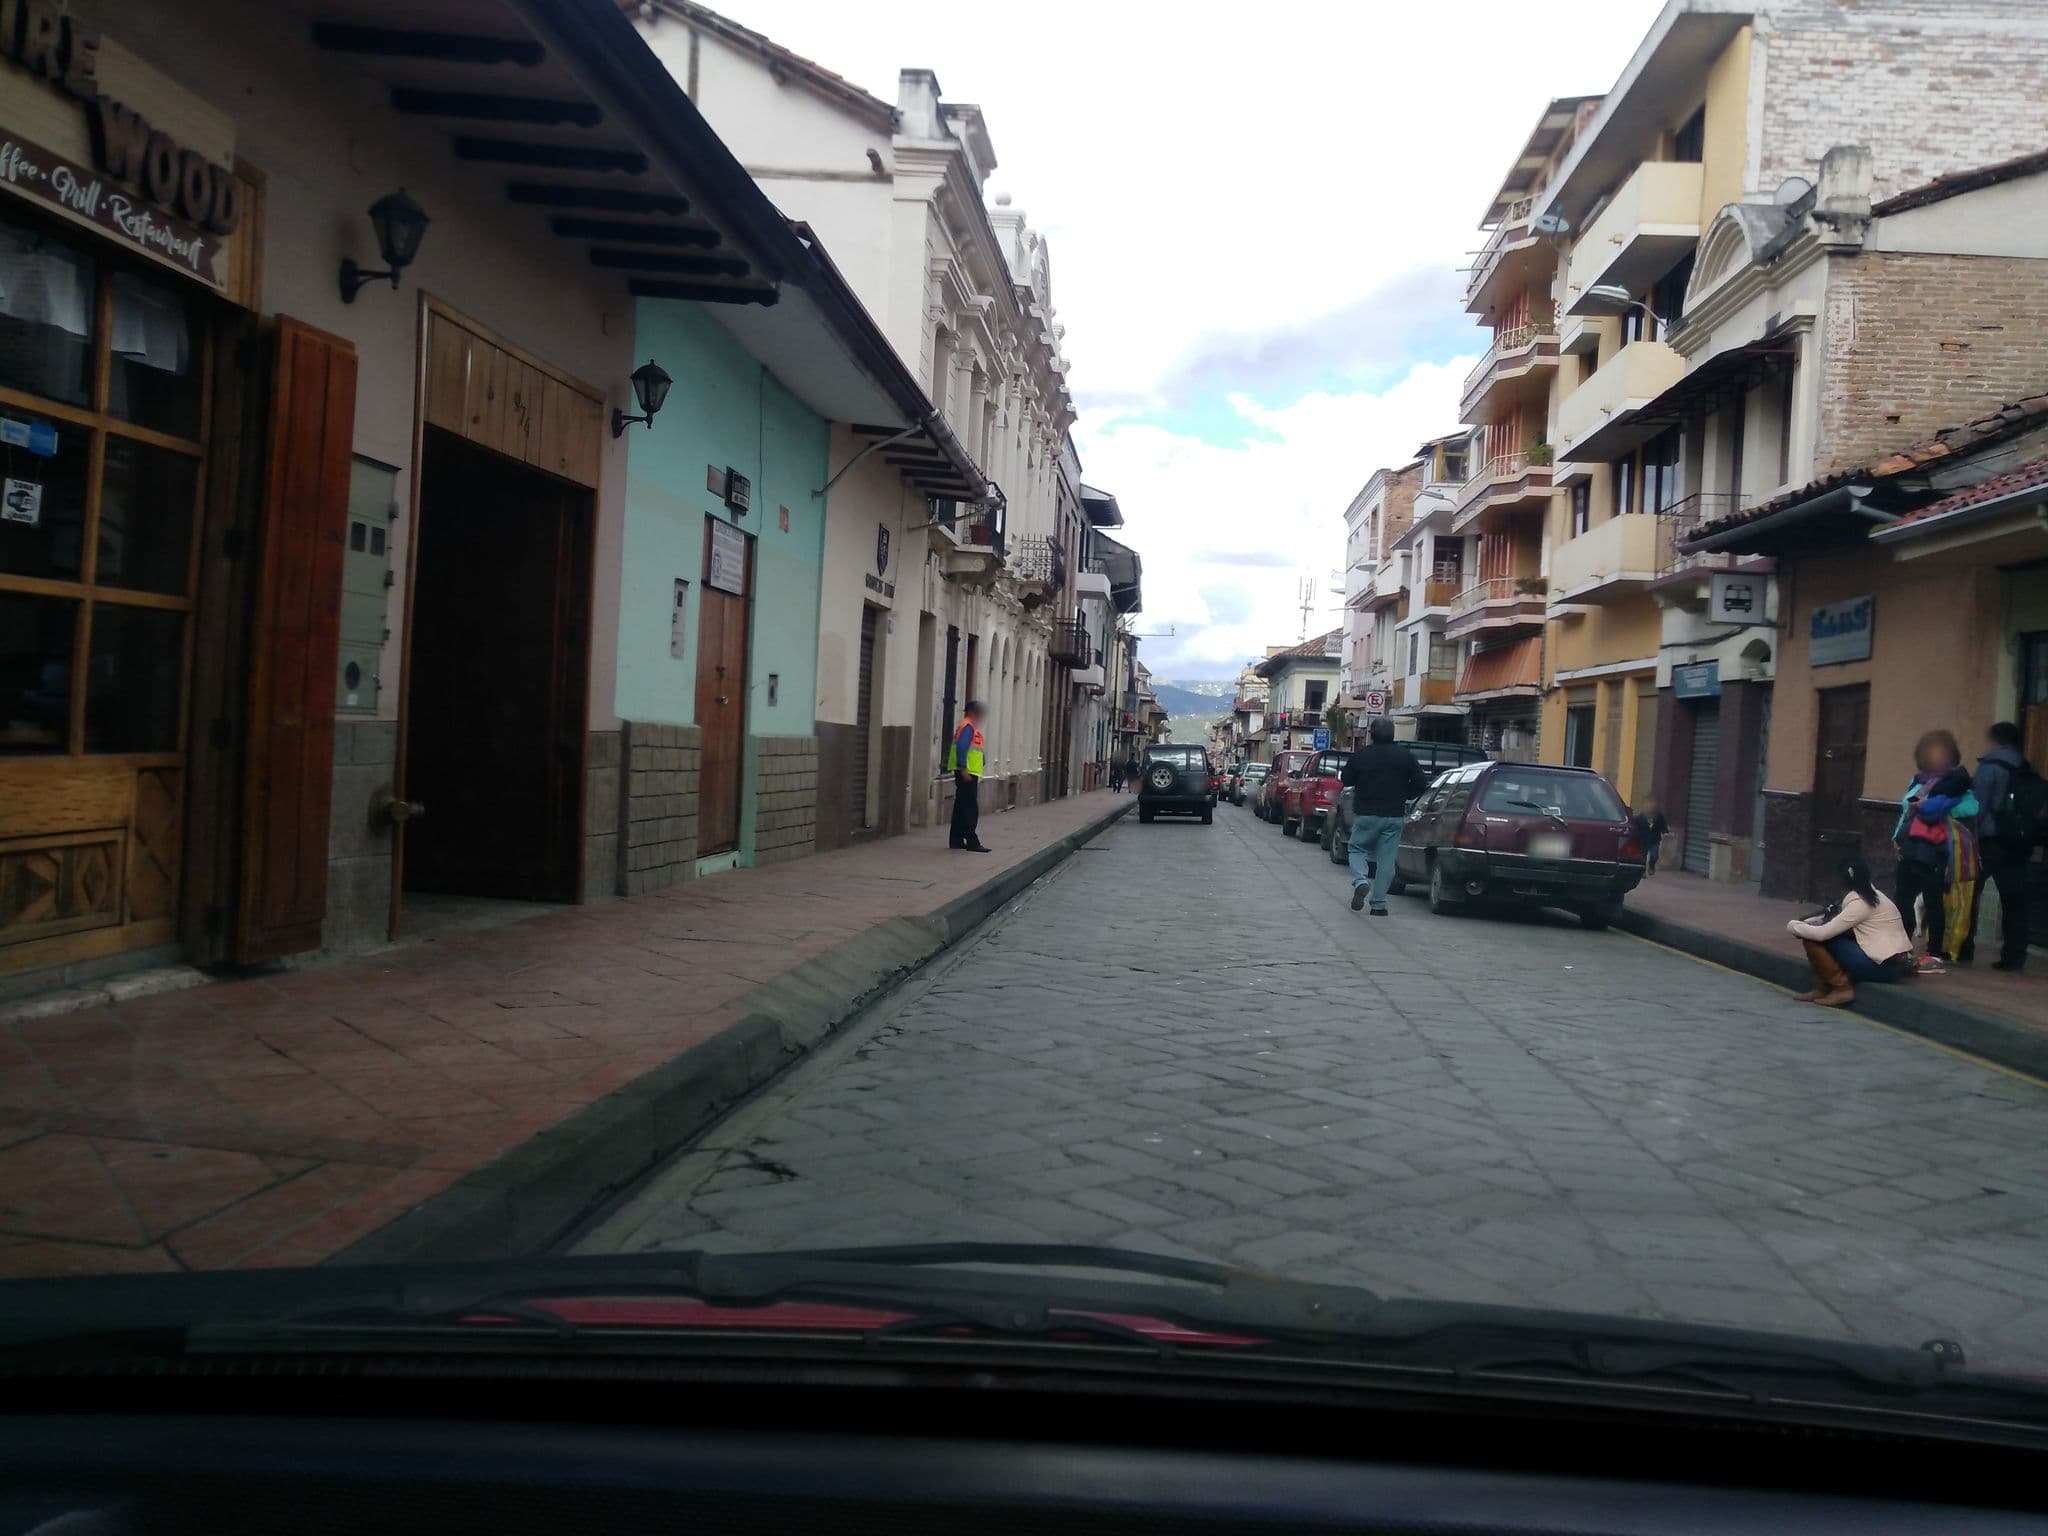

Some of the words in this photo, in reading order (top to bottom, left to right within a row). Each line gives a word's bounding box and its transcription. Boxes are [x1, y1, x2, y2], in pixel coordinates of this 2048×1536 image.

[52, 166, 101, 216] Grill
[109, 194, 204, 270] Restaurant
[90, 95, 238, 235] WOOD
